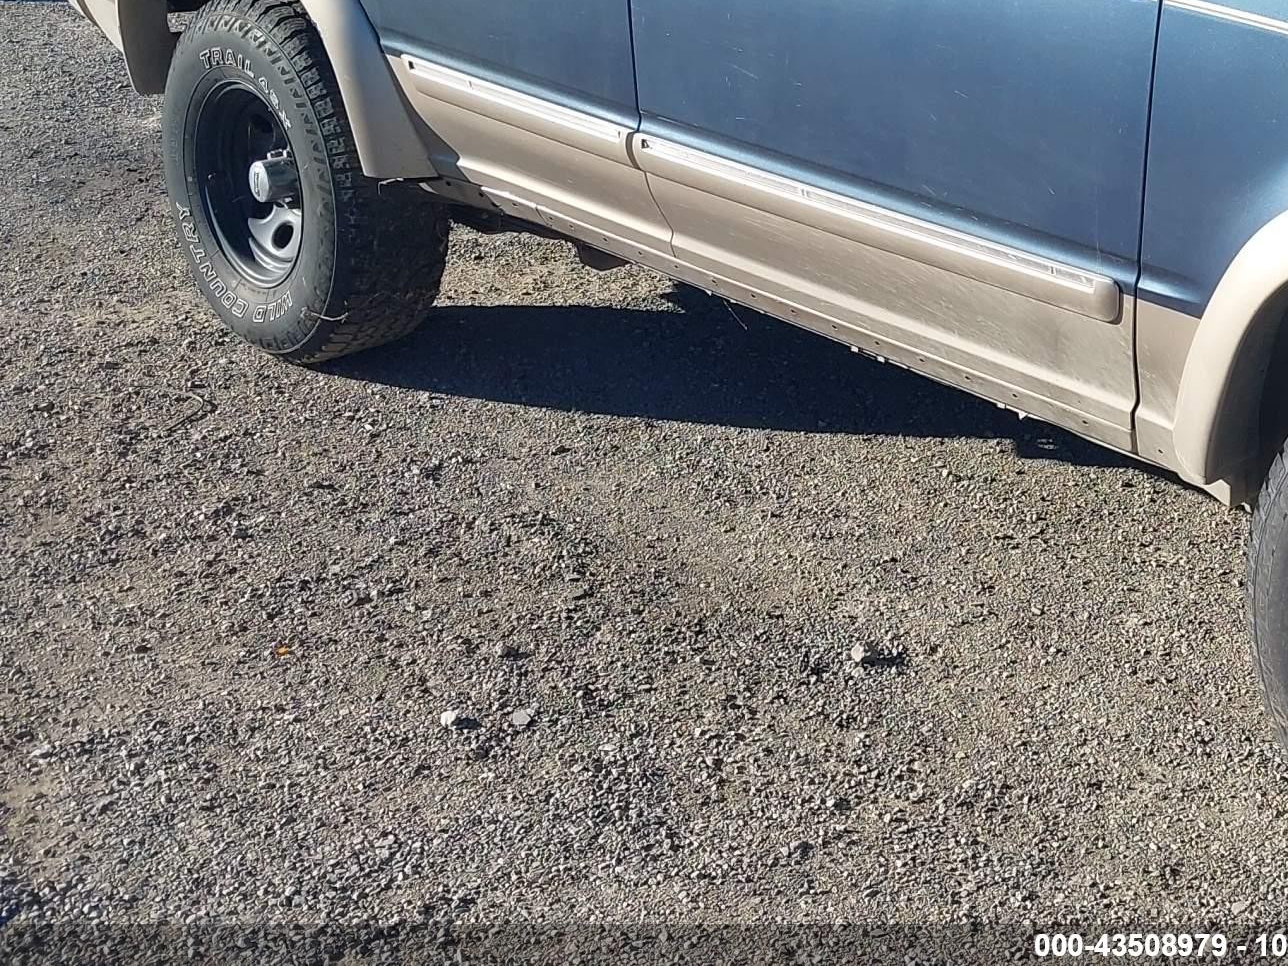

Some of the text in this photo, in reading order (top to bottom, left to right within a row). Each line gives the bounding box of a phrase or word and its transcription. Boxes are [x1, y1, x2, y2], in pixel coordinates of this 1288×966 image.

[199, 47, 255, 79] TRAIL
[175, 201, 293, 323] WILD COUNTRY
